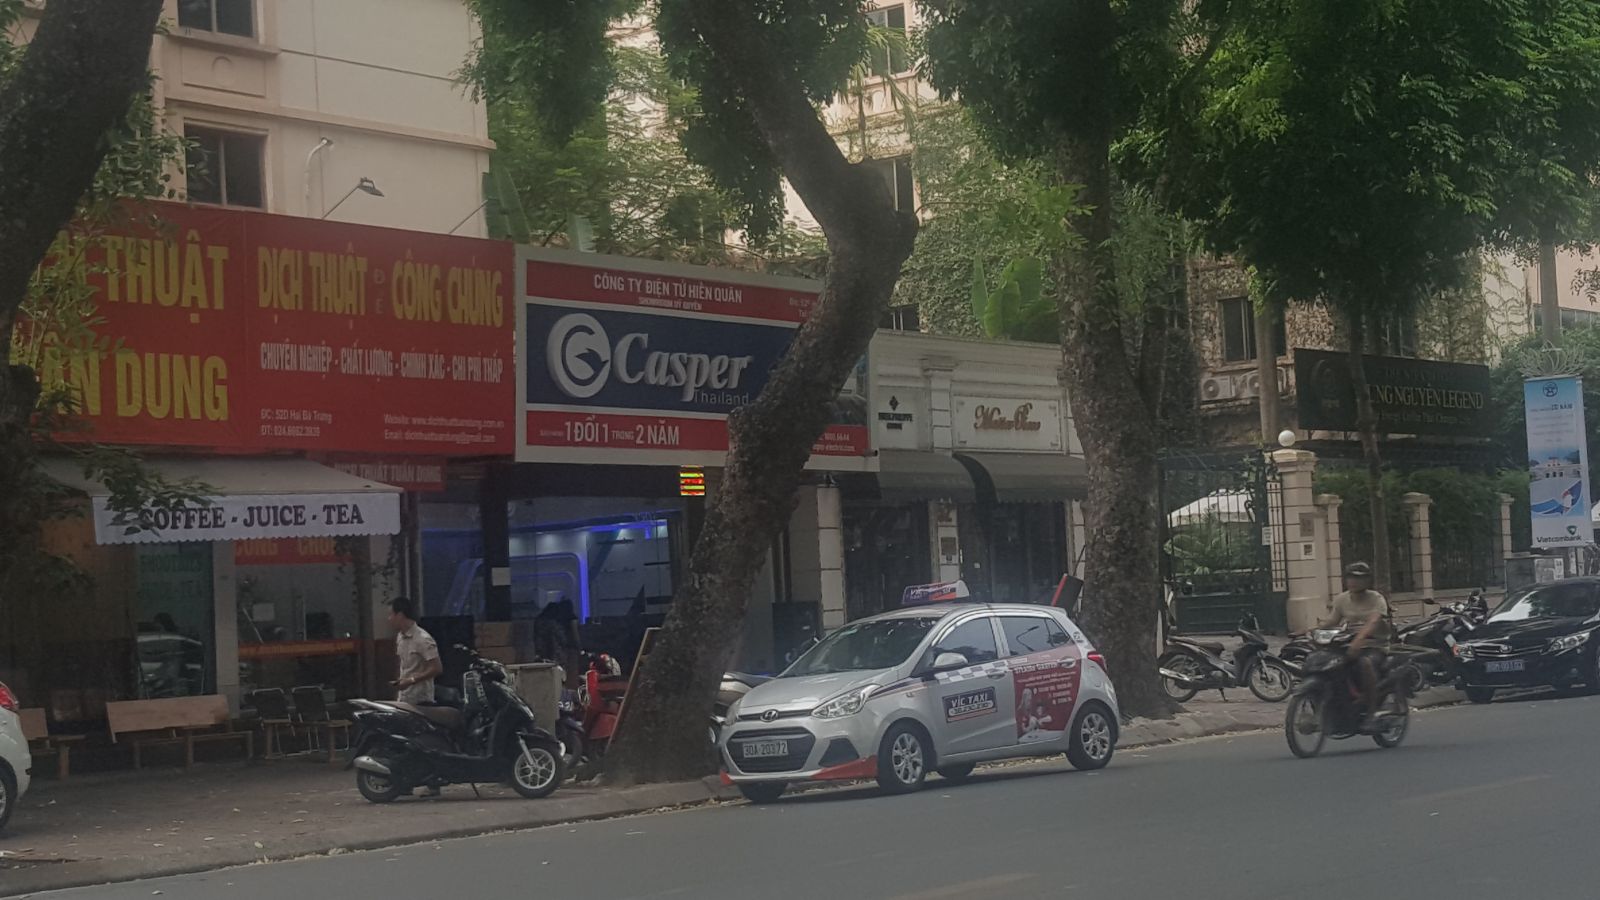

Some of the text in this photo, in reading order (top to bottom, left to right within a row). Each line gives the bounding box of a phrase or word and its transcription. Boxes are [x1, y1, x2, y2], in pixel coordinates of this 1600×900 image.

[104, 229, 229, 323] THUẬT
[258, 246, 304, 325] DỊCH
[309, 241, 369, 330] THUẬT
[392, 248, 442, 322] CÔNG
[448, 255, 504, 328] CHỨNG
[628, 277, 642, 293] TY
[645, 277, 670, 298] ĐIỆN
[714, 285, 743, 304] QUÂN
[428, 348, 445, 380] XÁC
[613, 332, 753, 402] Casper
[115, 350, 229, 422] DUNG
[1442, 389, 1484, 409] LEGEND
[564, 420, 571, 441] 1
[574, 414, 600, 443] ĐỔI
[602, 423, 609, 443] 1
[635, 424, 645, 444] 2
[647, 419, 679, 446] NĂM
[140, 503, 364, 530] COFFEE JUICE TEA
[1536, 535, 1583, 543] Vietcombank
[951, 692, 988, 708] VIC TAXI
